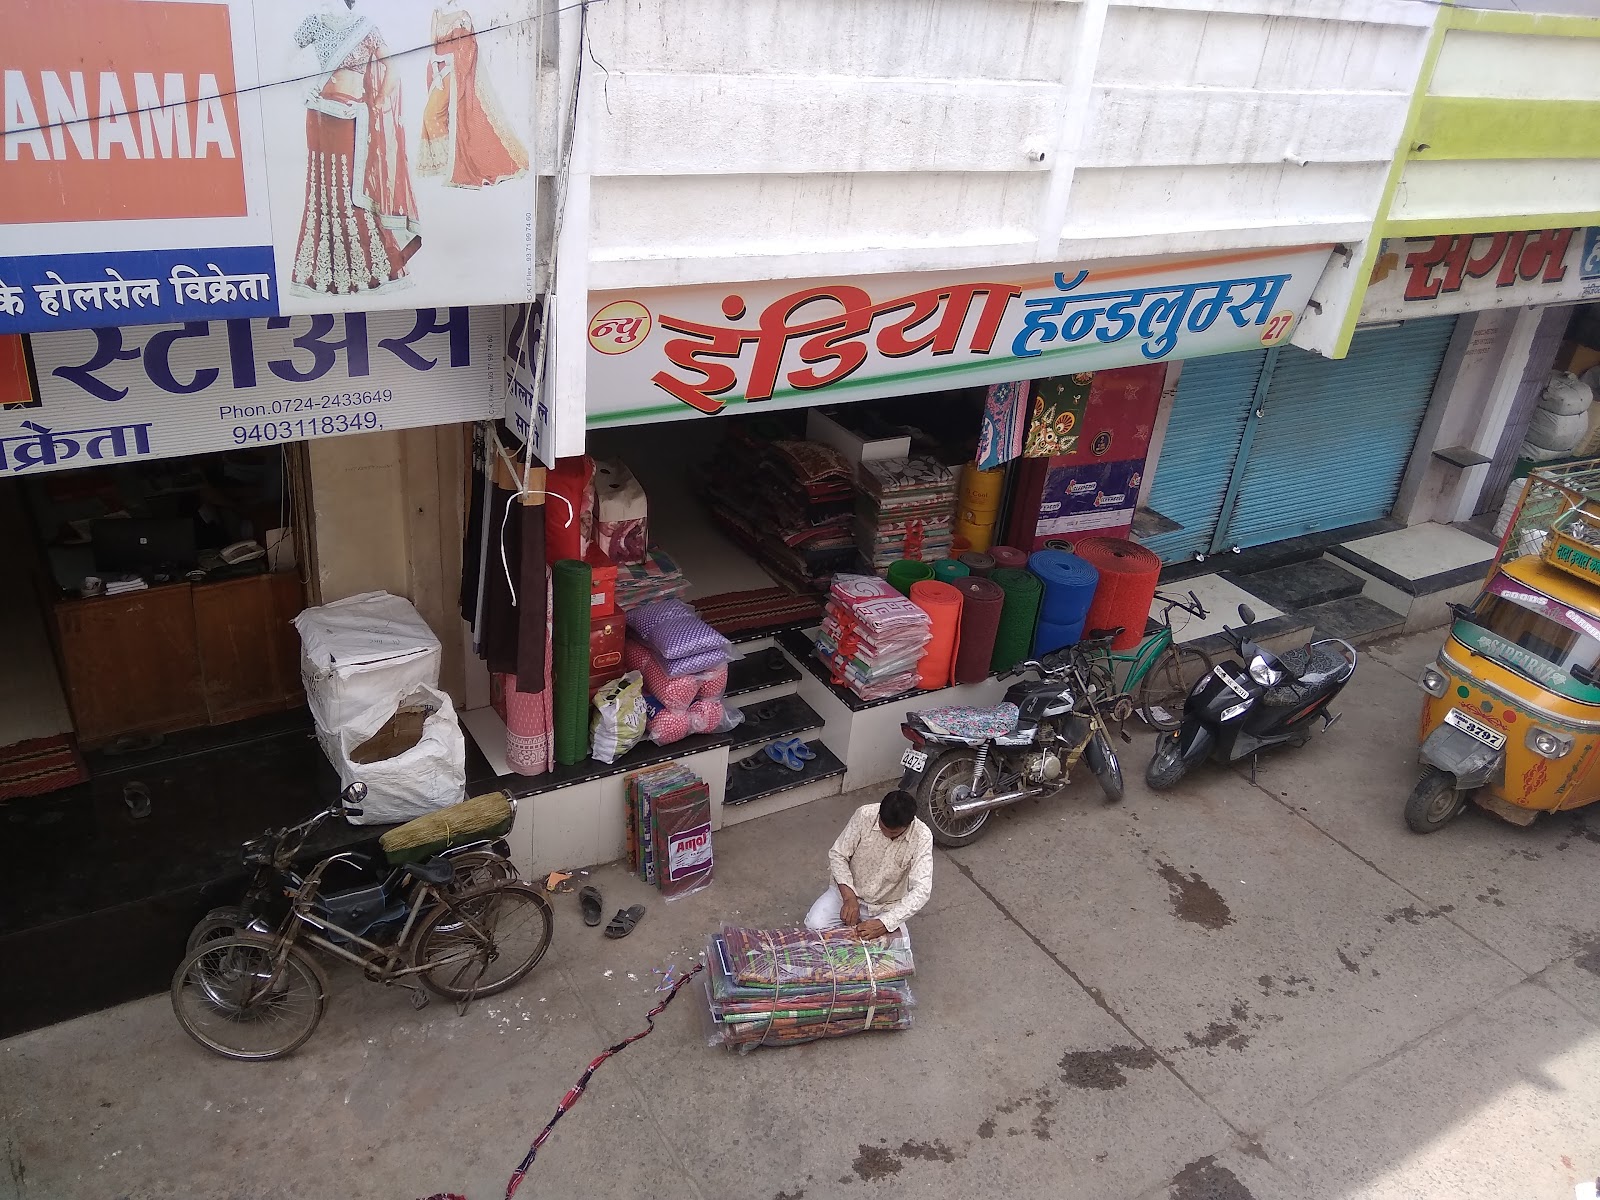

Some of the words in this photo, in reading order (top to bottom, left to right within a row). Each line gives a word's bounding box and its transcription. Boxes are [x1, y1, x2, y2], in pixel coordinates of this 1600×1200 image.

[4, 70, 235, 161] ANAMA
[33, 267, 160, 317] होलसेल
[168, 263, 271, 305] विक्रेता
[651, 283, 1022, 415] इंडिया
[1262, 315, 1292, 341] 27
[0, 420, 153, 472] क्रेता
[1466, 723, 1500, 745] 3797
